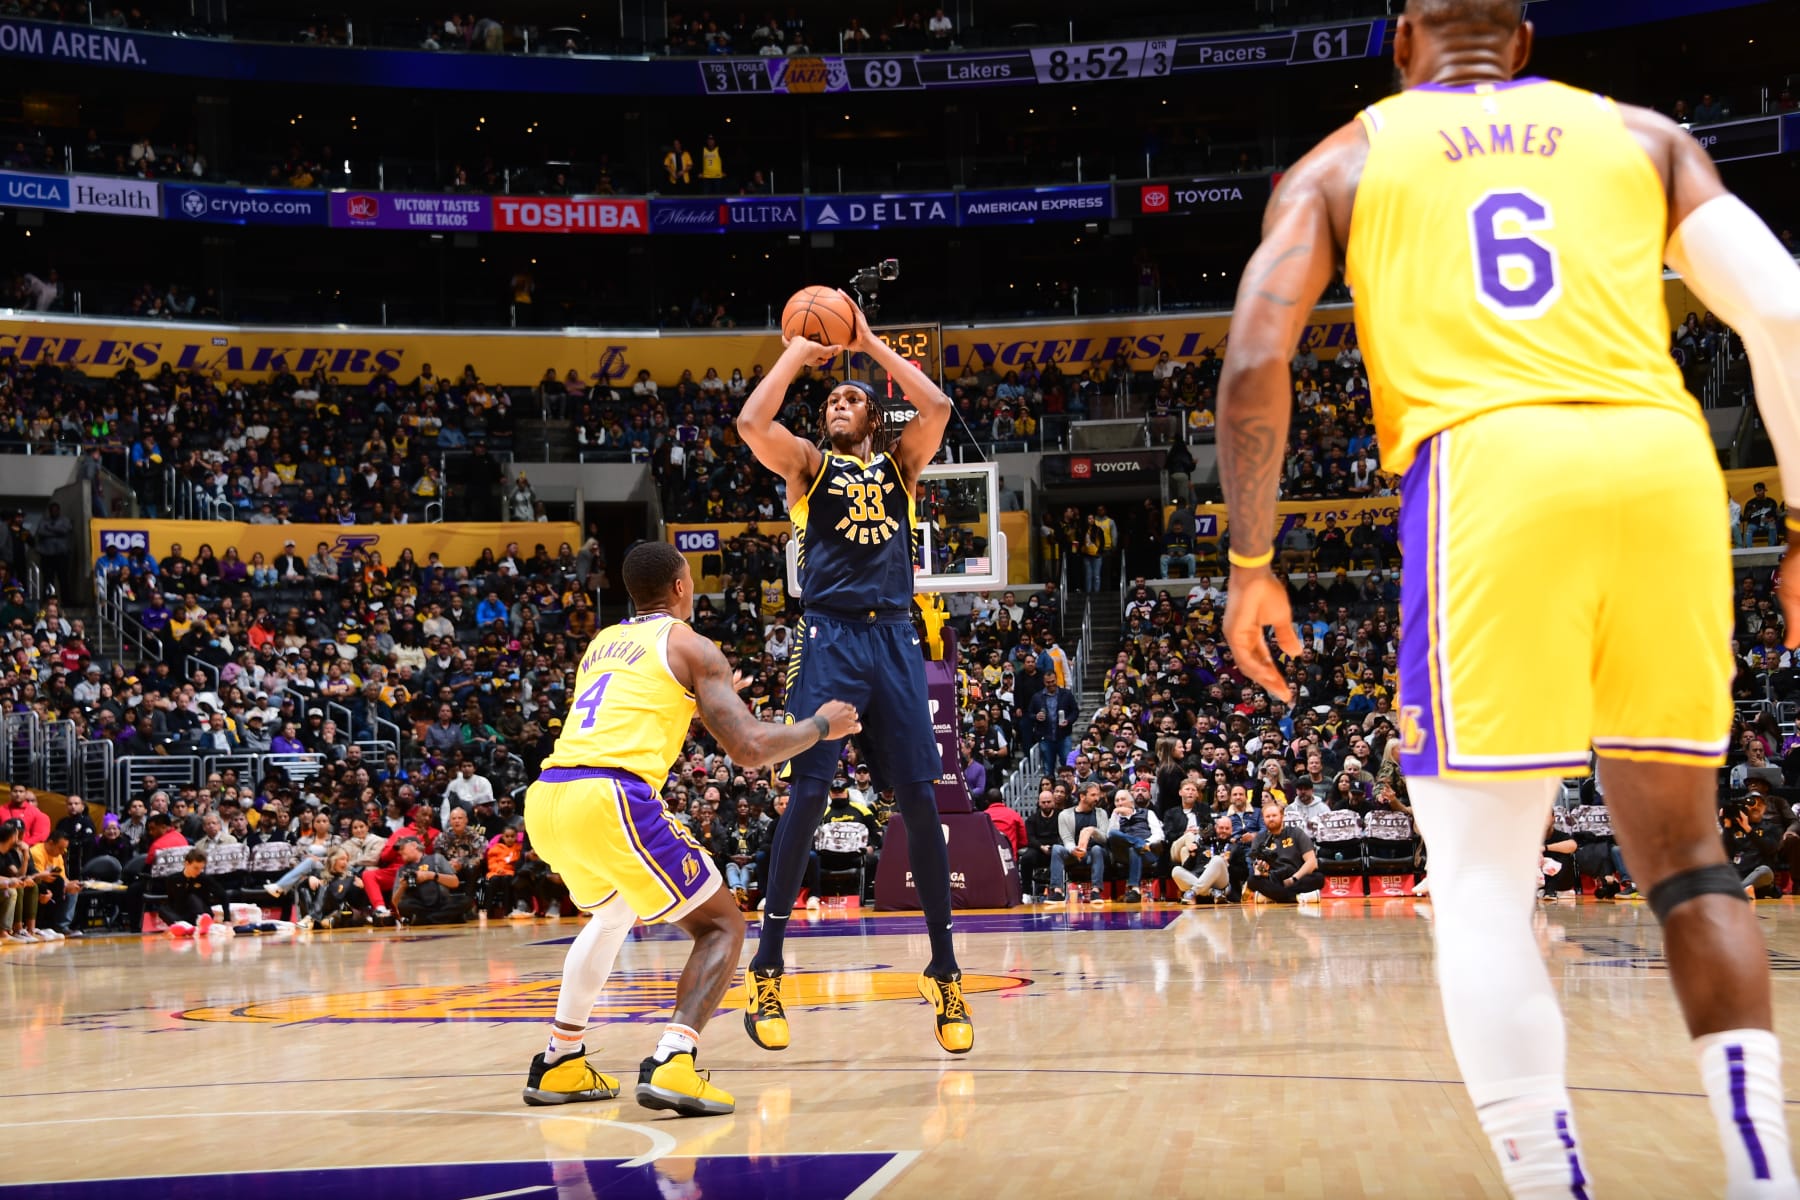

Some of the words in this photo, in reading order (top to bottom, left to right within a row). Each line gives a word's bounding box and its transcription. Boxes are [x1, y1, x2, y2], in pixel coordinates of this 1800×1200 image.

[0, 25, 44, 54] OM
[52, 31, 147, 65] ARENA.
[1151, 40, 1167, 49] QTR
[1313, 29, 1348, 59] 61
[1153, 52, 1167, 75] 3
[1200, 46, 1266, 63] Pacers
[710, 64, 727, 72] TOL
[737, 63, 764, 71] FOULS
[947, 62, 1011, 80] Lakers
[1049, 46, 1128, 82] 8:52
[716, 73, 728, 91] 3
[748, 73, 757, 90] 1
[775, 64, 843, 88] LAKERS
[865, 60, 901, 88] 69
[1439, 124, 1563, 162] JAMES
[8, 181, 61, 201] UCLA
[77, 185, 151, 210] Health
[1175, 187, 1243, 204] TOYOTA
[211, 199, 311, 215] crypto.com
[394, 198, 439, 212] VICTORY
[442, 200, 480, 213] TASTES
[654, 207, 716, 224] Michelob
[731, 205, 797, 223] ULTRA
[850, 202, 946, 221] DELTA
[967, 201, 1038, 215] AMERICAN
[1041, 197, 1103, 210] EXPRESS
[409, 213, 433, 225] LIKE
[435, 214, 468, 226] TACOS
[500, 203, 641, 228] TOSHIBA
[1470, 190, 1558, 315] 6
[176, 344, 404, 373] LAKERS
[1094, 461, 1140, 472] TOYOTA
[847, 483, 886, 521] 33
[834, 516, 899, 544] PACERS
[105, 532, 146, 550] 106
[678, 533, 716, 550] 106
[582, 641, 634, 673] WALKER
[625, 645, 646, 665] IV
[575, 672, 613, 730] 4
[1326, 819, 1355, 828] DELTA
[1379, 819, 1409, 828] DELTA
[1588, 814, 1611, 822] DELT
[168, 855, 185, 863] DEL
[215, 852, 243, 862] DELTA
[264, 850, 292, 858] DELTA
